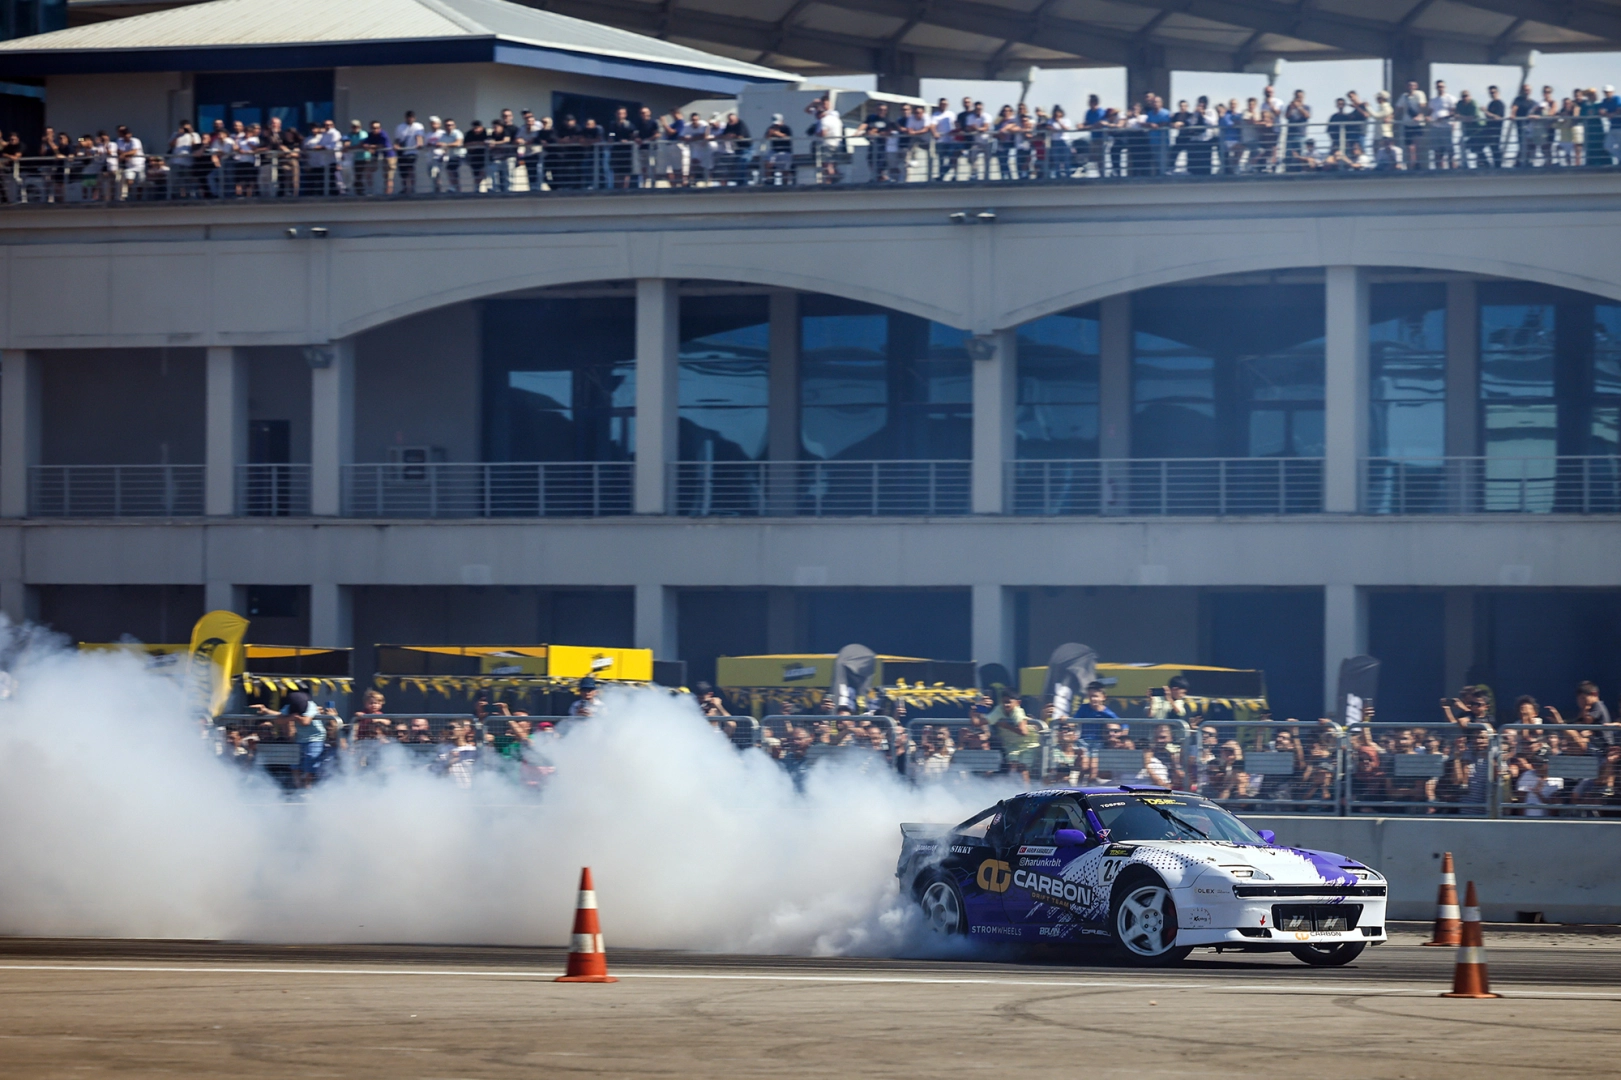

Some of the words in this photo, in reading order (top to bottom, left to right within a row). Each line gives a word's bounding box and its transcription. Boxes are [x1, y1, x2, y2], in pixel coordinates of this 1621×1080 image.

[1104, 859, 1122, 882] 21
[1013, 869, 1092, 906] CARBON
[1031, 892, 1050, 902] DRIFT
[1051, 897, 1070, 907] TEAM
